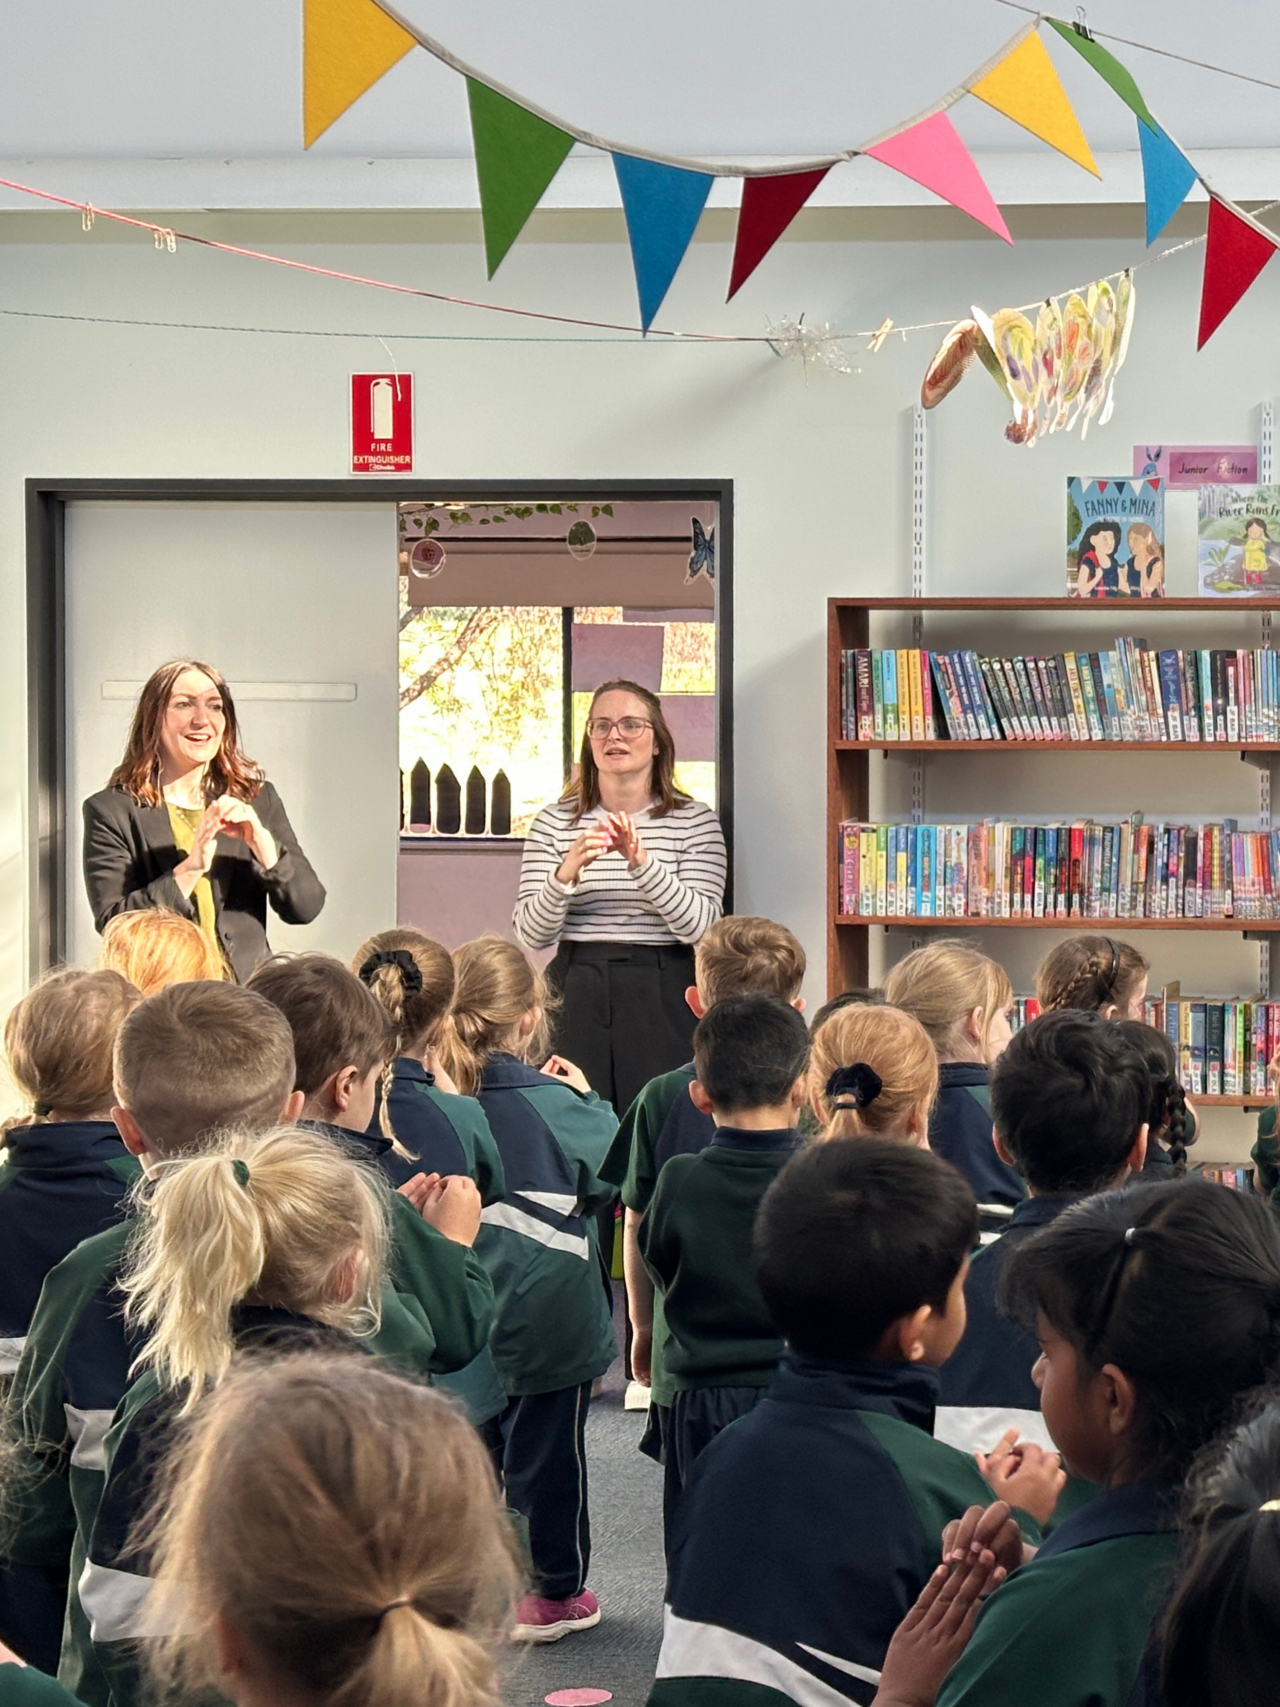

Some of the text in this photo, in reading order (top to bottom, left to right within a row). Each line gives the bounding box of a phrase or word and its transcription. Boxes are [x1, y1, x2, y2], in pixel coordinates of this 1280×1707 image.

[370, 443, 393, 452] FIRE
[353, 455, 412, 464] EXTINGUISHER
[1178, 461, 1249, 474] Junior Fiction
[1231, 491, 1256, 504] Where
[1084, 497, 1156, 518] FANNY & MINA
[1219, 506, 1244, 518] River
[1246, 504, 1269, 516] Runs
[857, 655, 869, 688] AMARI
[1171, 724, 1180, 739] BAR
[1211, 1011, 1220, 1043] Dark Fire
